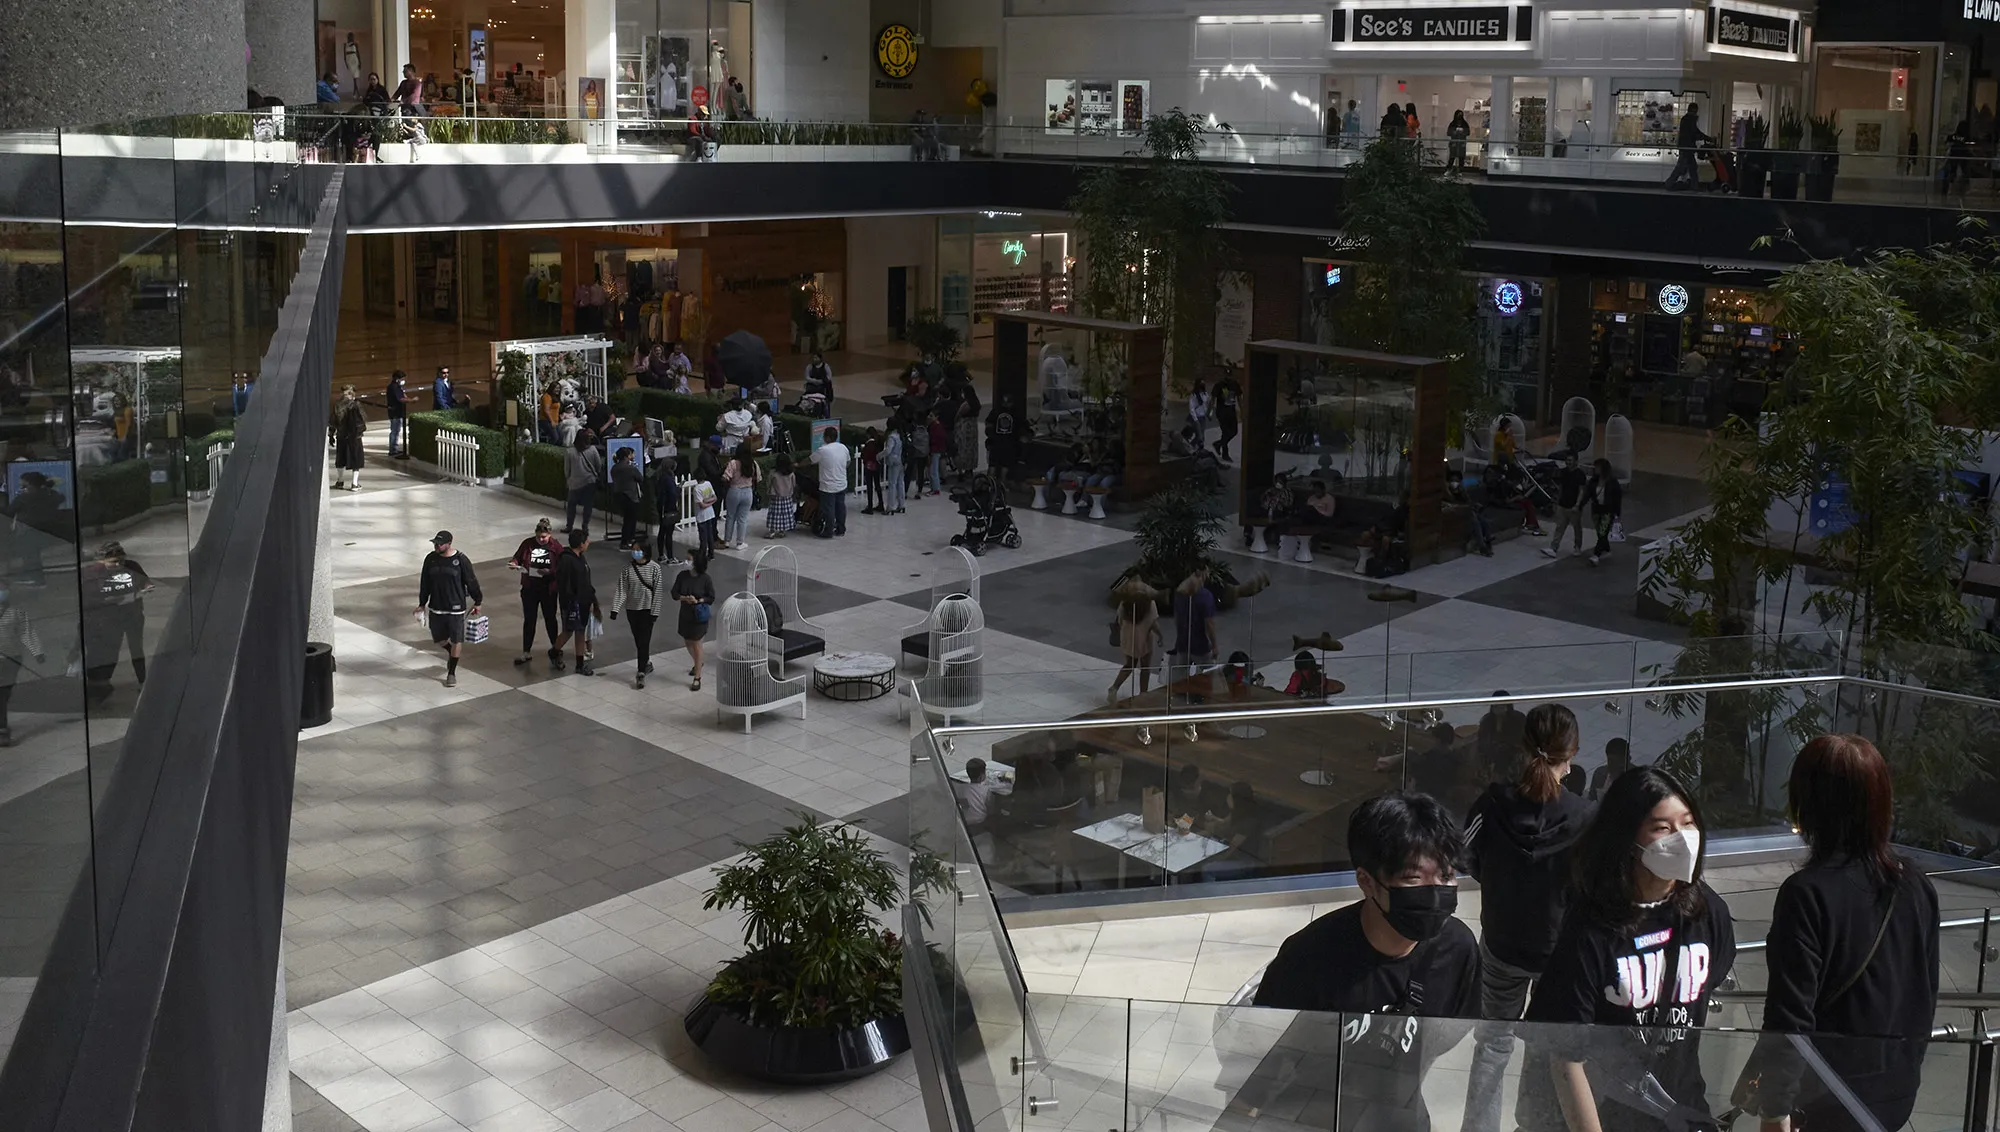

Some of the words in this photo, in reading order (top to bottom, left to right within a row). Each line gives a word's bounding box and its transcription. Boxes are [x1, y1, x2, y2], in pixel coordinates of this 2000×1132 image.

[1361, 15, 1413, 36] See's
[1424, 20, 1500, 36] CANDIES
[1721, 15, 1749, 41] See's
[1752, 27, 1787, 46] CANDIES
[883, 62, 915, 76] GYM
[875, 79, 914, 90] Entrance
[1639, 934, 1660, 946] COME
[1660, 930, 1671, 940] ON
